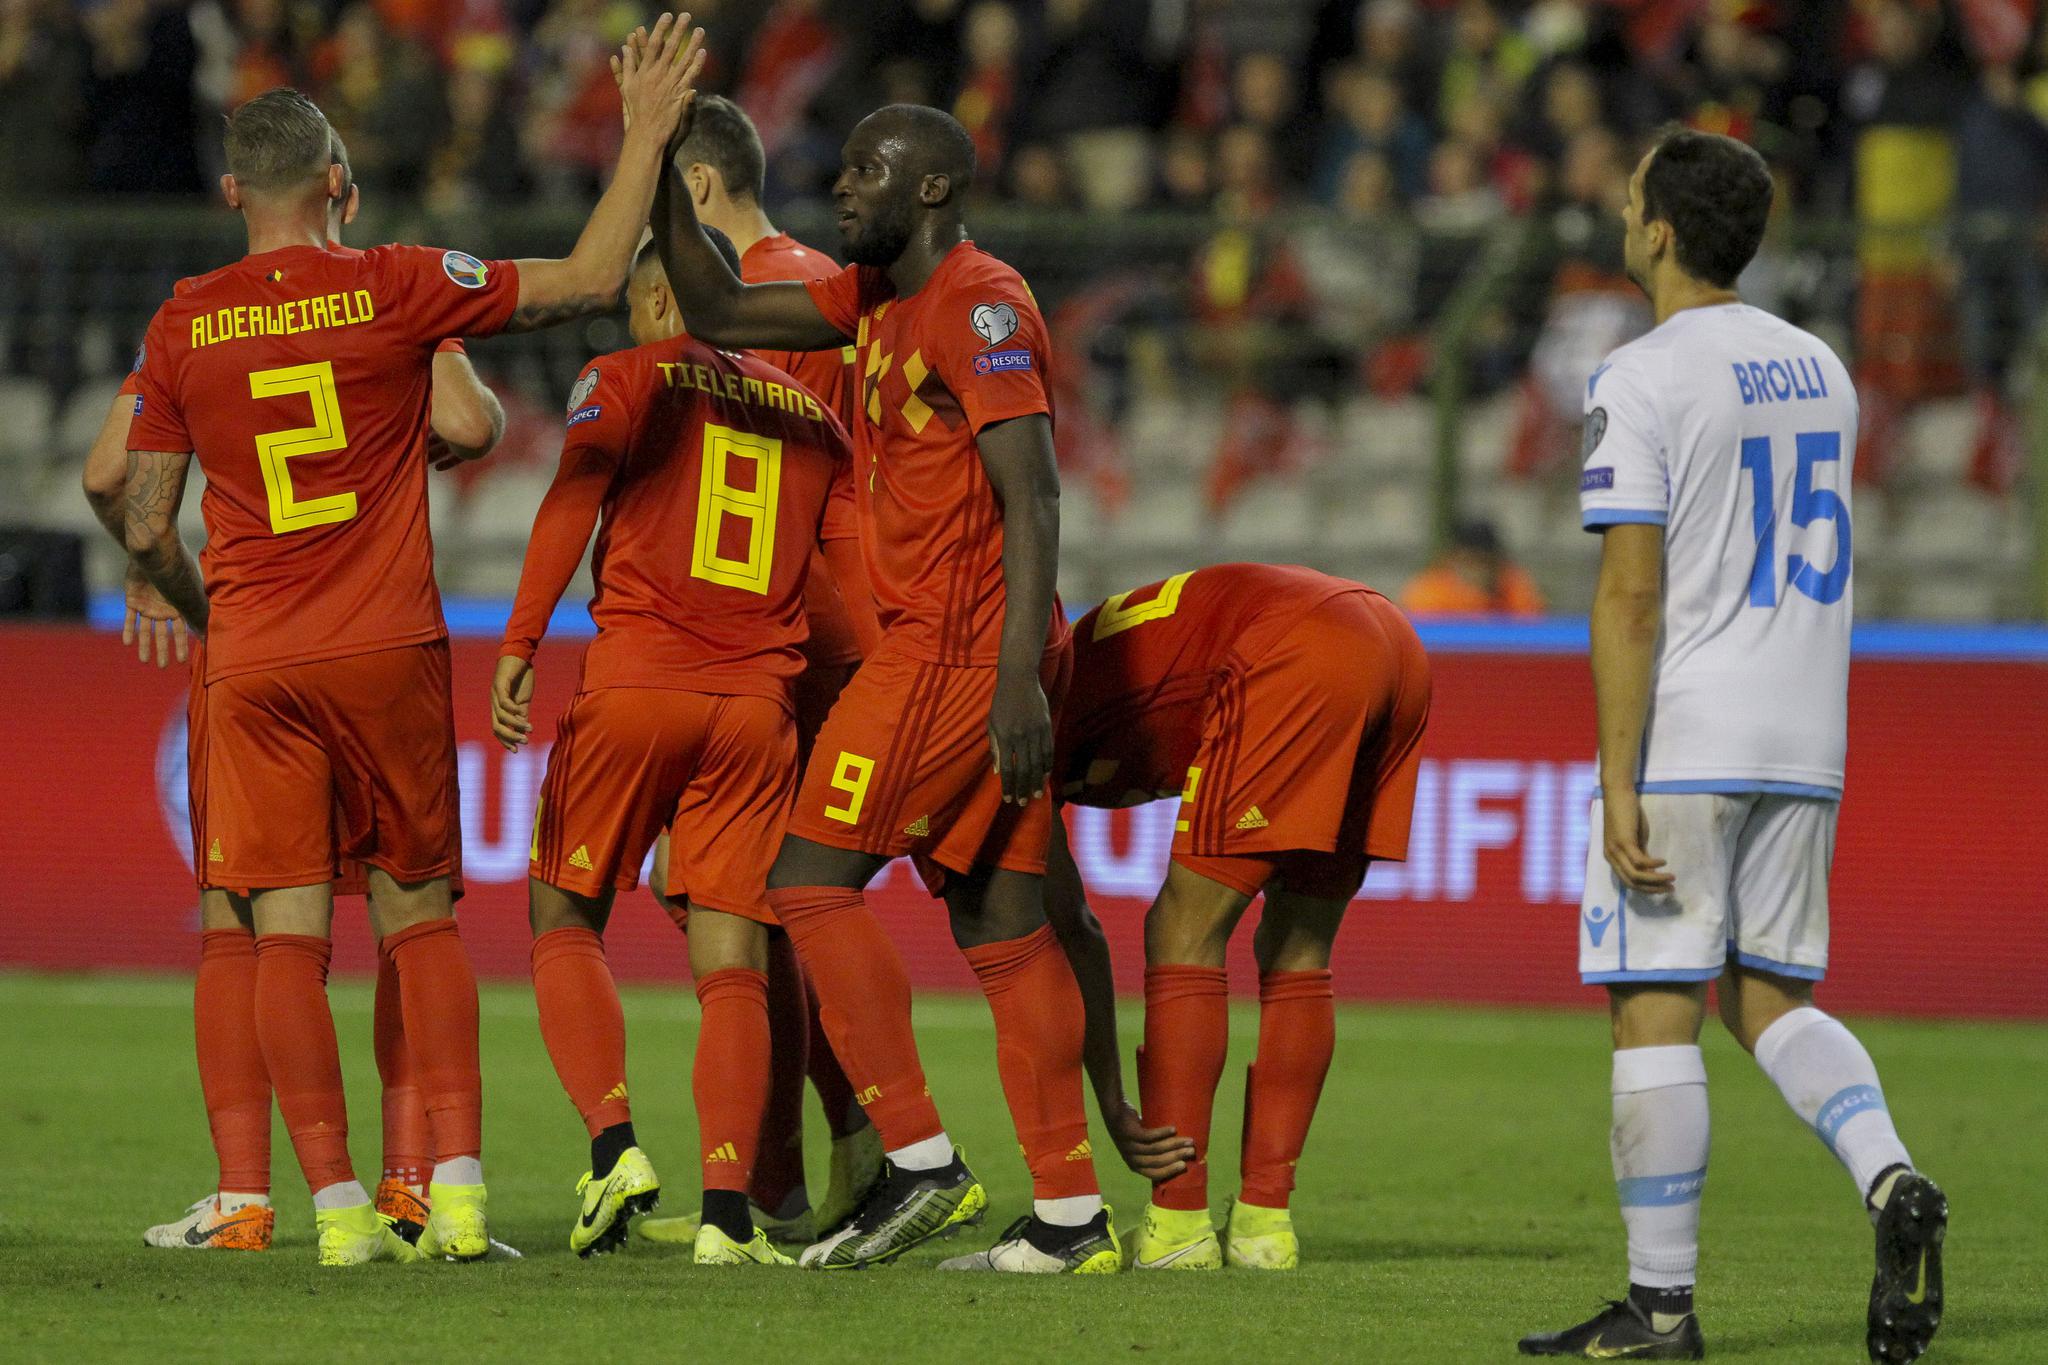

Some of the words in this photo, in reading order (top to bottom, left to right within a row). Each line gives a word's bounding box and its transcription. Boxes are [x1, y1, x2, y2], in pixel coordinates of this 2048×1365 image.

[192, 290, 374, 348] ALDERWEIRELD
[992, 356, 1030, 366] RESPECT
[1732, 357, 1828, 405] BROLLI
[657, 363, 823, 422] TIELEMANS
[249, 361, 357, 534] 2
[690, 421, 782, 596] 8
[1741, 431, 1852, 607] 15
[824, 751, 875, 825] 9
[1235, 819, 1269, 829] adidas
[568, 857, 593, 871] adidas
